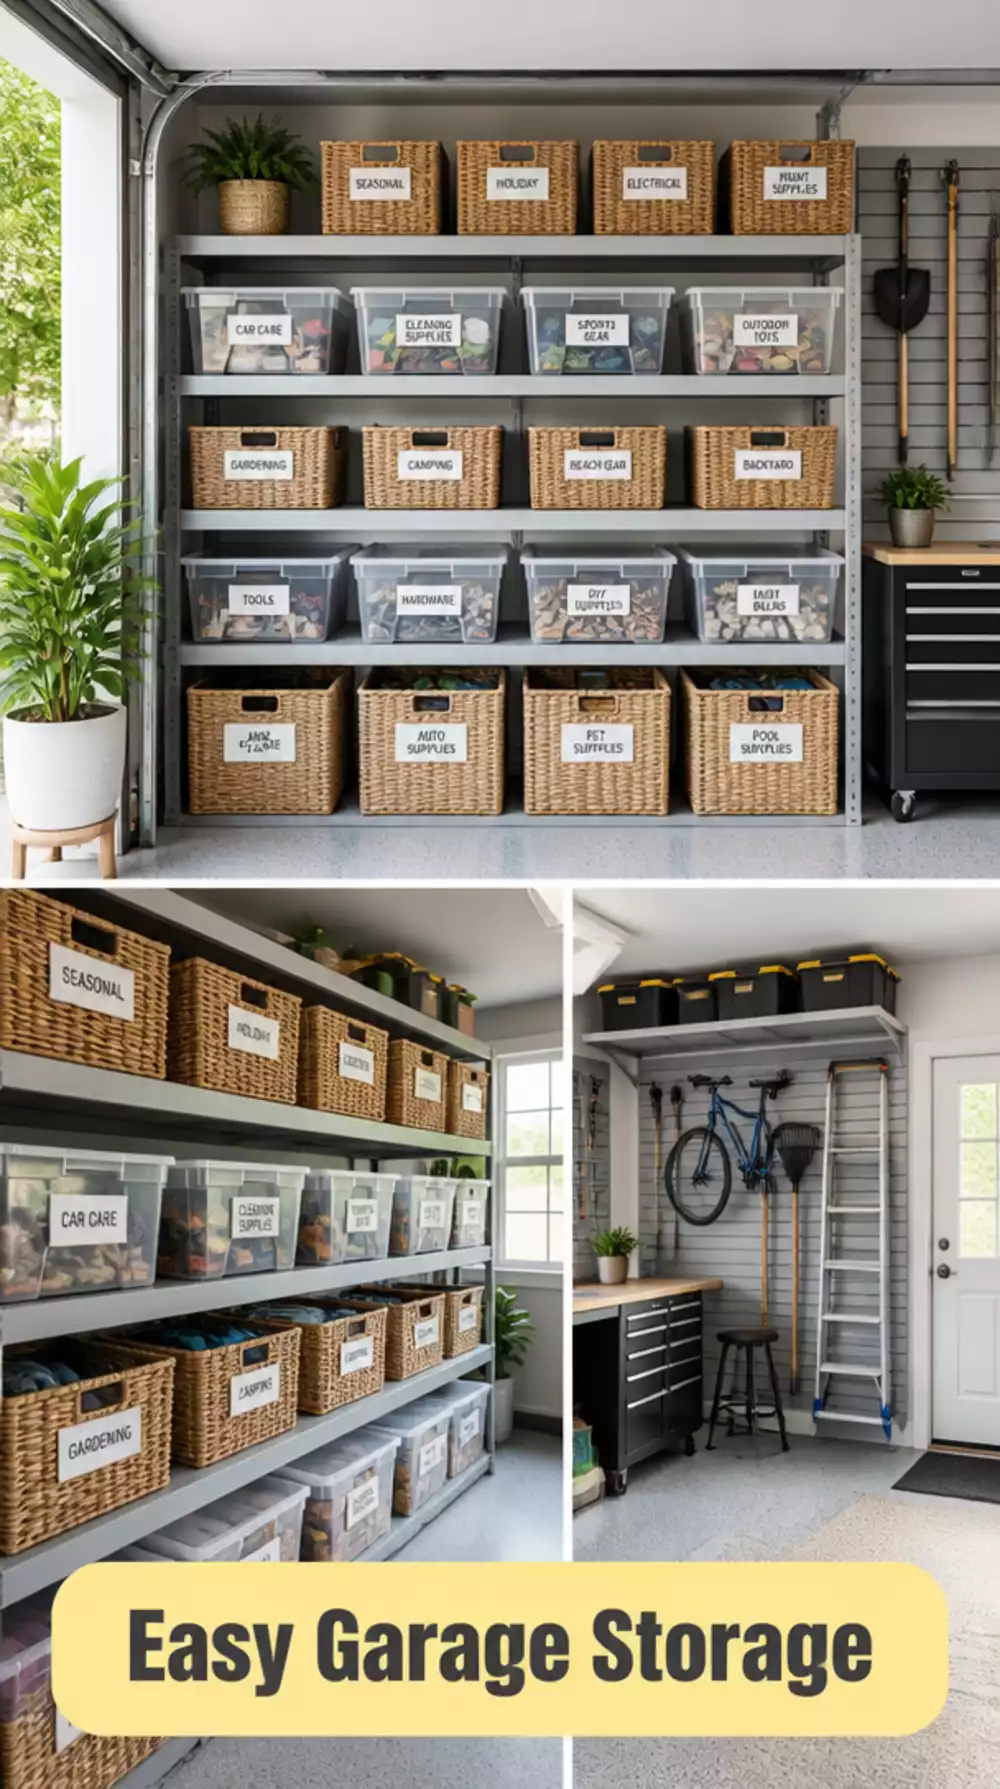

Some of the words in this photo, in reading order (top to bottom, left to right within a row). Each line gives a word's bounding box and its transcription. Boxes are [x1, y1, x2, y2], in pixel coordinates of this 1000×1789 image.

[242, 594, 276, 606] TOOLS
[62, 966, 125, 1002] SEASONAL
[62, 1210, 86, 1229] CAR
[89, 1210, 118, 1228] CARE
[68, 1424, 132, 1461] GARDENING
